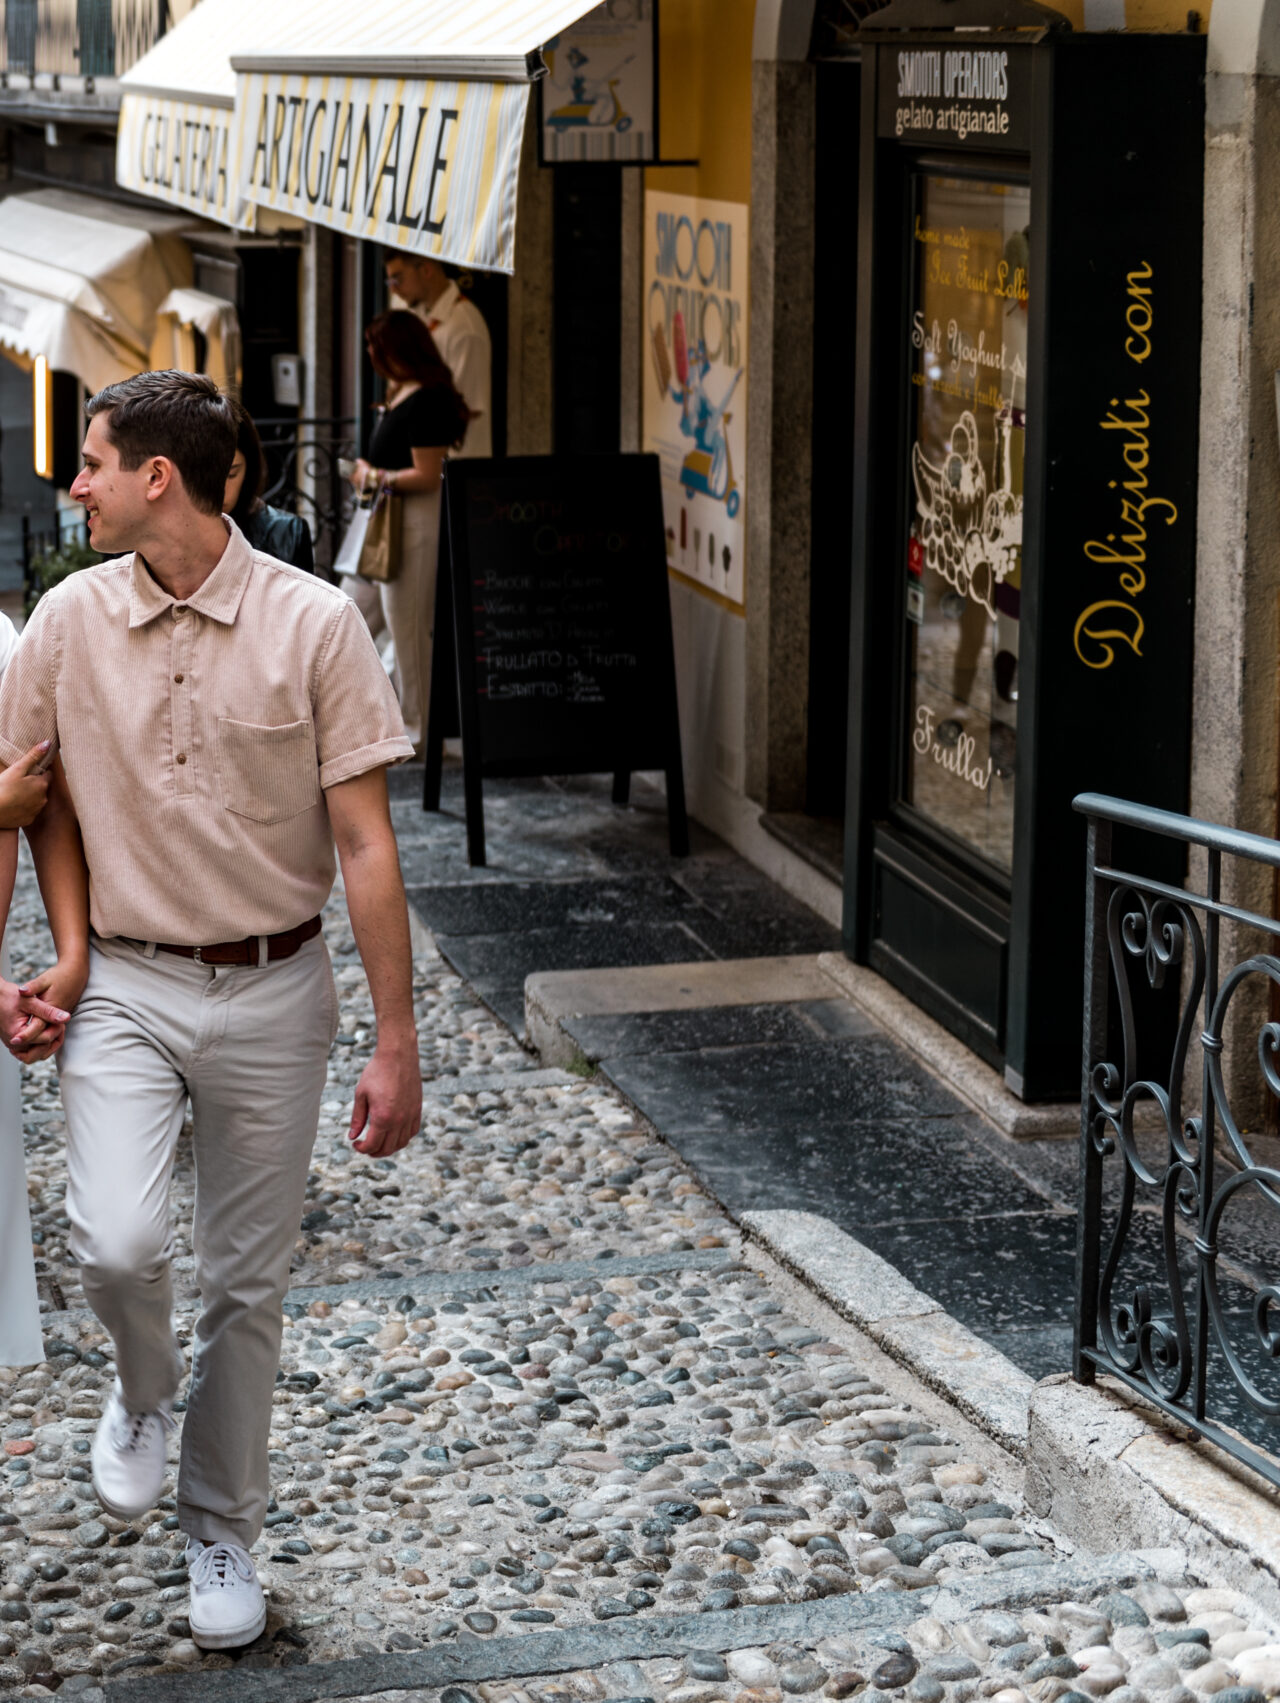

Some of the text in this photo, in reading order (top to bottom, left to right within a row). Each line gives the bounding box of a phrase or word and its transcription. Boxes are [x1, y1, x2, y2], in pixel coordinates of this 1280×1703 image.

[898, 51, 1008, 101] SMOOTH OPERATORS
[896, 100, 1010, 140] gelato artigianale
[249, 94, 459, 235] ARTIGIANALE
[656, 211, 732, 292] SMOOTH
[947, 318, 1007, 378] Yoghurt
[1073, 260, 1178, 670] Deliziati con
